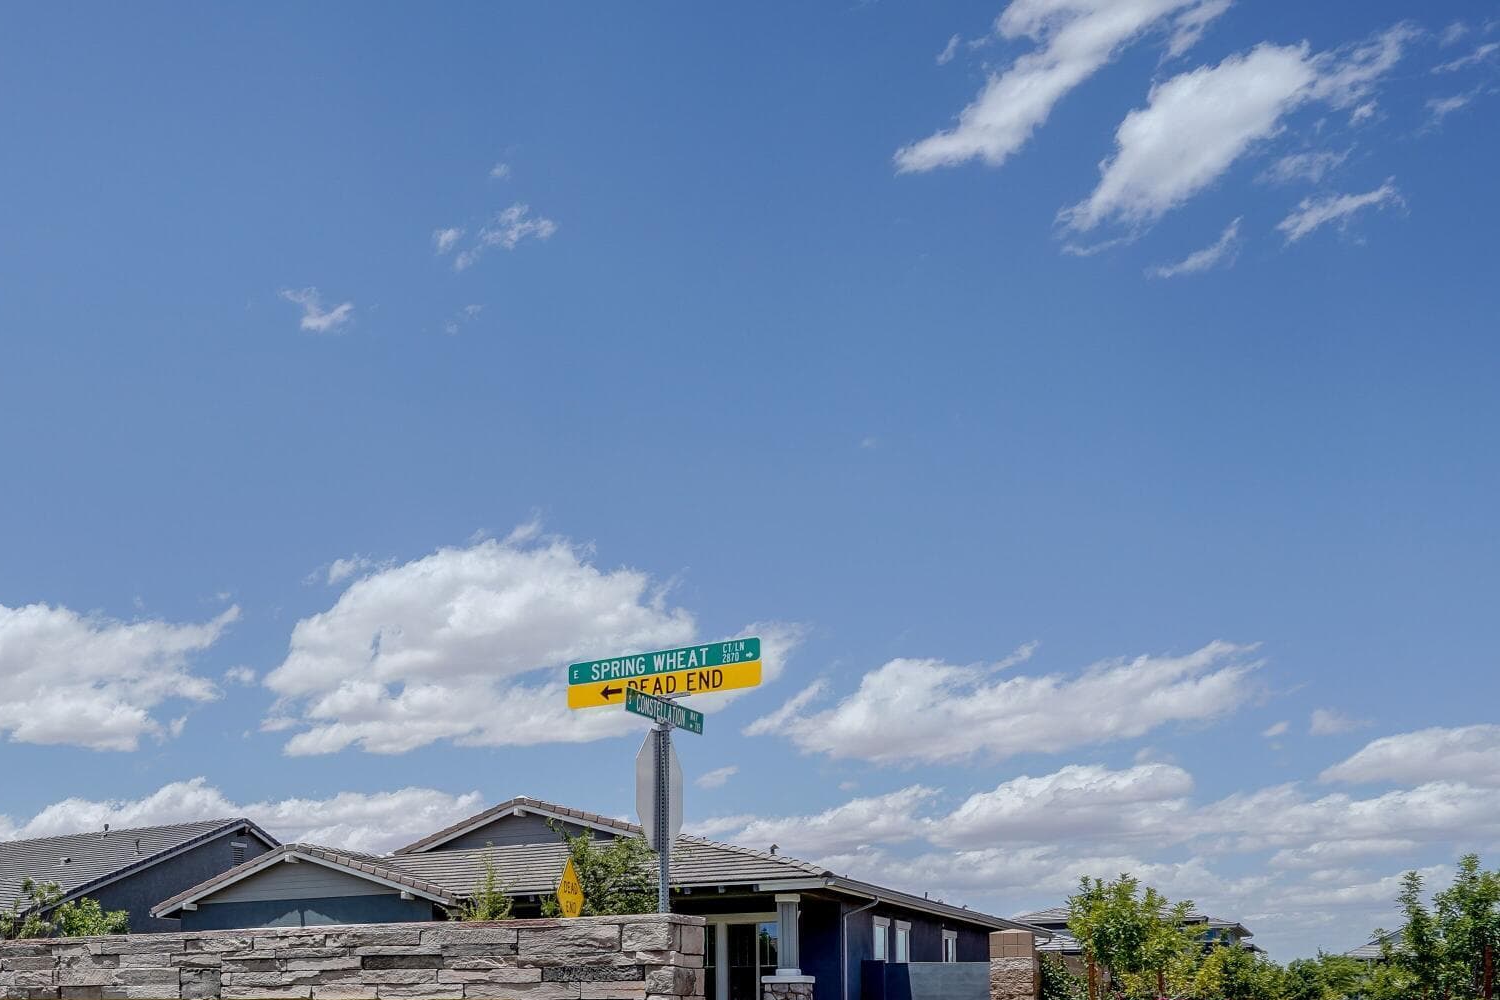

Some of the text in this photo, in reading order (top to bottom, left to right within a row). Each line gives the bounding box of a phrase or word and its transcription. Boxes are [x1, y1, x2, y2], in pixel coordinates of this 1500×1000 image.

[722, 641, 745, 654] CT/LN
[573, 647, 709, 681] E SPRING WHEAT
[722, 652, 740, 664] 2870
[686, 669, 723, 692] END
[628, 694, 686, 727] S CONSTELLATION
[563, 881, 578, 895] DEAD
[566, 901, 577, 913] END
